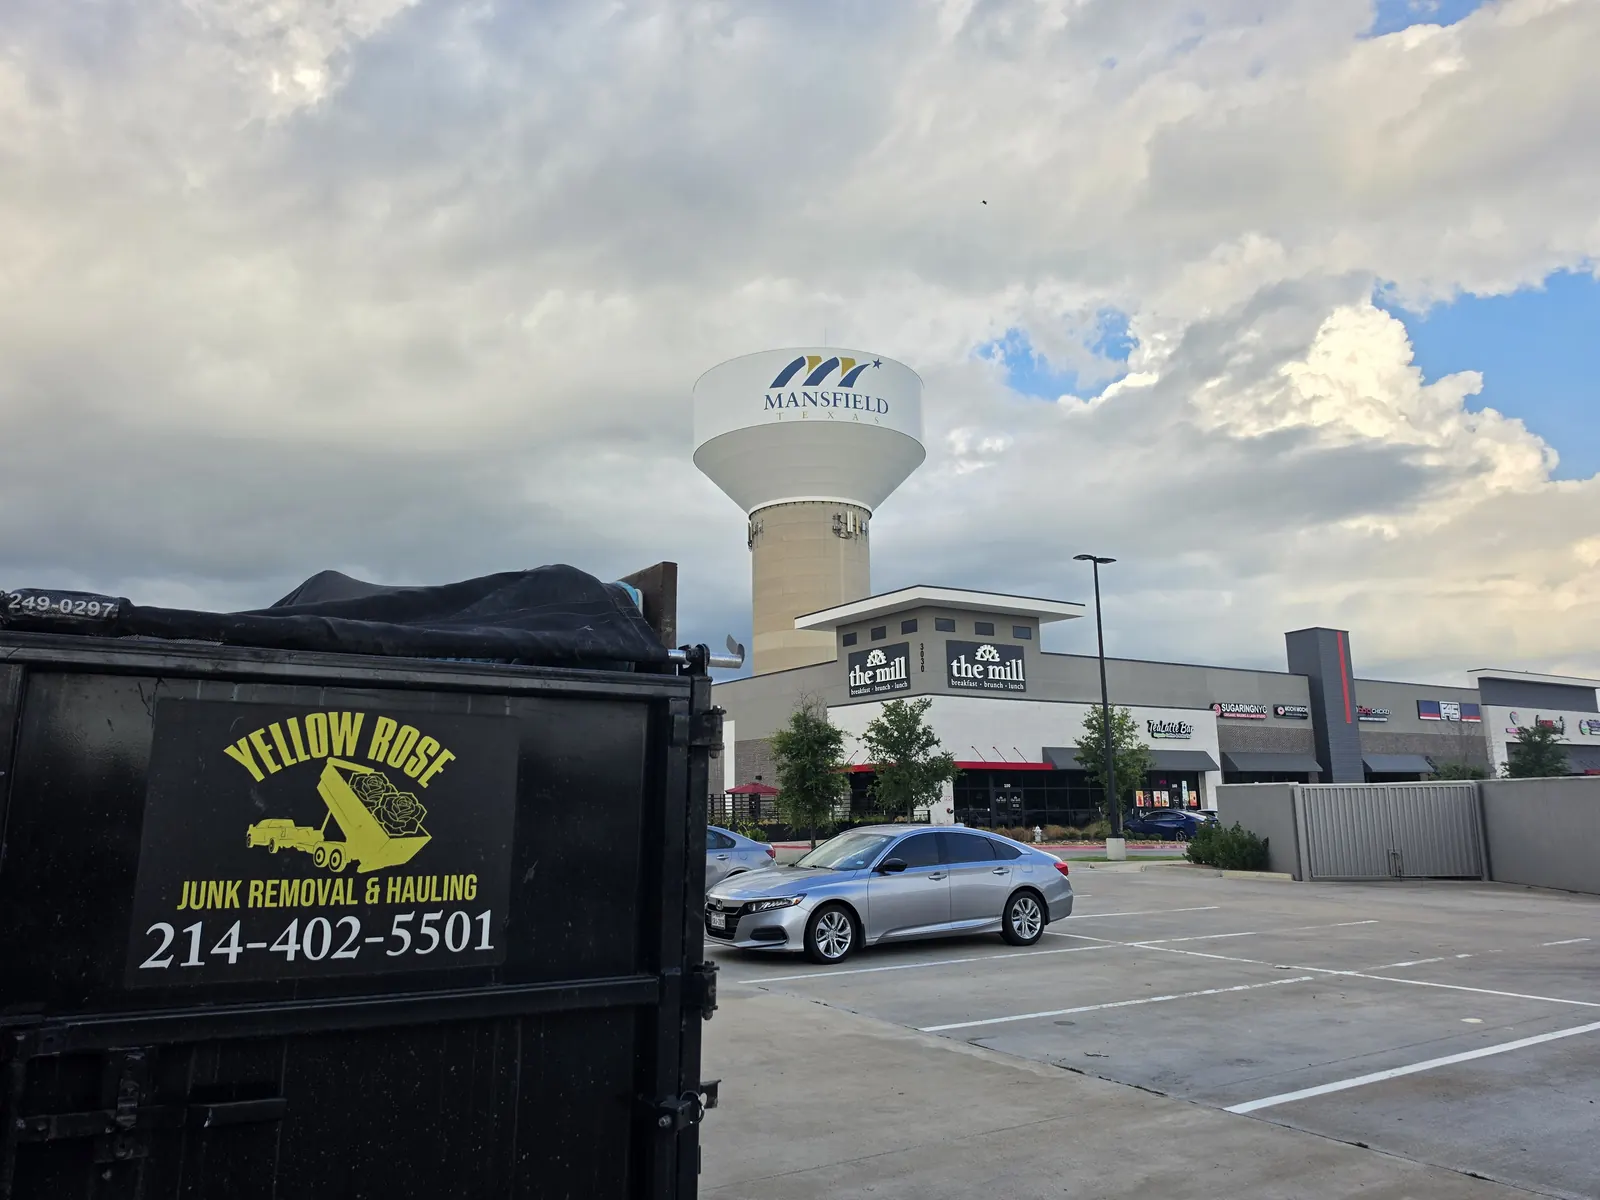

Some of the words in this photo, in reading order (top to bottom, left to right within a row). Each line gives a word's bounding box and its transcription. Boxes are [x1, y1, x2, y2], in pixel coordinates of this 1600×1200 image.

[764, 391, 889, 415] MANSFIELD
[776, 411, 880, 424] TEXAS
[8, 593, 115, 617] 249-0297
[849, 664, 875, 687] the
[875, 656, 908, 681] mill
[951, 655, 984, 679] the
[986, 659, 1025, 681] mill
[851, 687, 871, 696] breakfast
[875, 684, 891, 692] brunch
[894, 681, 908, 689] lunch
[951, 679, 978, 687] breakfast
[984, 681, 1004, 689] brunch
[1008, 682, 1024, 690] lunch
[1221, 703, 1268, 714] SUGARINGNYC
[1178, 721, 1194, 735] Bar
[224, 711, 365, 782] YELLOW
[367, 715, 456, 789] ROSE
[176, 879, 241, 911] JUNK
[248, 877, 356, 909] REMOVAL
[364, 877, 380, 905] &
[386, 873, 478, 903] HAULING
[138, 908, 496, 969] 214-402-5501
